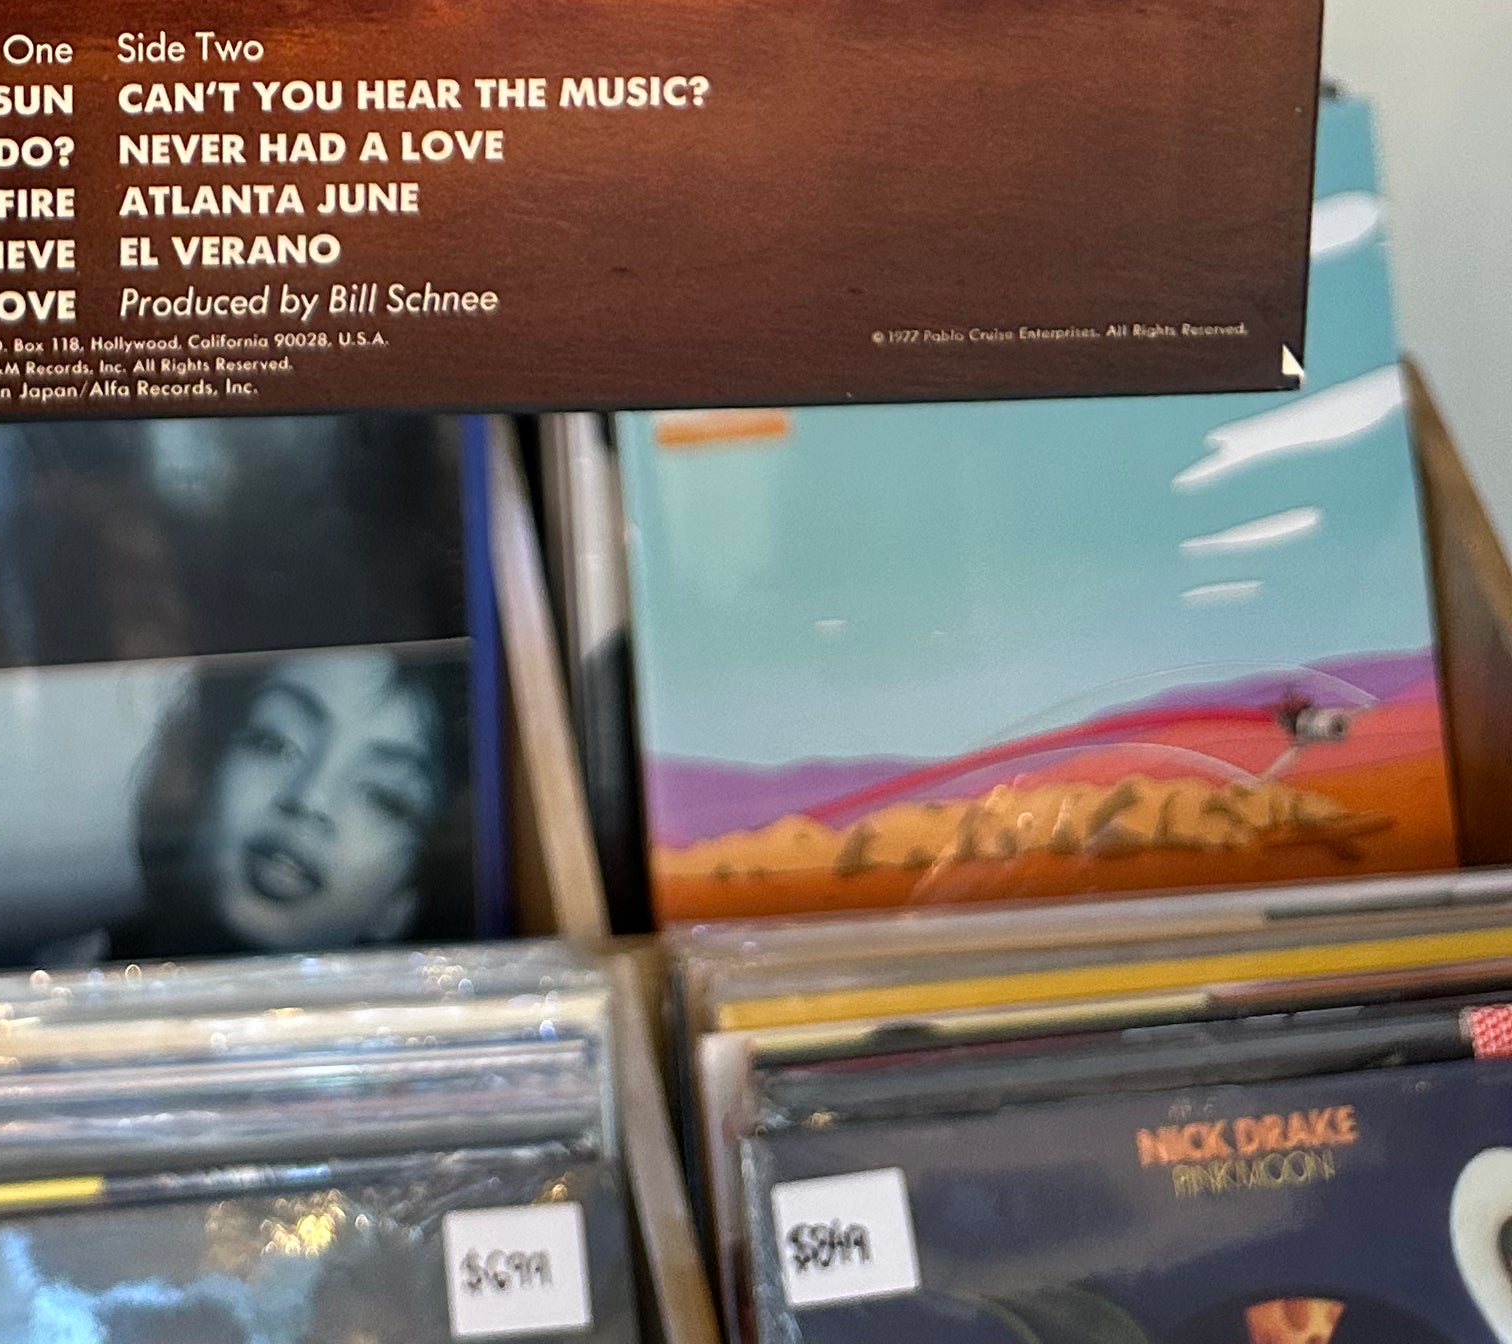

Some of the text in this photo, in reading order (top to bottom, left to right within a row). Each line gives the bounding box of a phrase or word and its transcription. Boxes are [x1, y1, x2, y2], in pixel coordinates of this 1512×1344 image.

[2, 33, 74, 67] One
[117, 30, 265, 65] Side Two
[118, 75, 711, 115] CAN'T YOU HEAR THE MUSIC?
[119, 129, 505, 166] NEVER HAD A LOVE
[118, 182, 420, 217] ATLANTA JUNE
[119, 233, 342, 270] EL VERANO
[119, 281, 499, 324] Produced by Bill Schnee
[13, 337, 44, 353] Box
[52, 336, 85, 354] 118,
[90, 335, 183, 354] Hollywood,
[188, 333, 270, 350] California
[273, 332, 333, 349] 90028,
[338, 331, 390, 347] U.S.A.
[888, 329, 920, 343] 1977
[923, 328, 965, 343] Pablo
[968, 327, 1014, 342] Cruise
[1105, 323, 1128, 338] All
[1131, 322, 1177, 339] Rights
[1181, 321, 1249, 337] Reserved.
[25, 359, 94, 376] Records,
[99, 358, 127, 374] Inc.
[132, 357, 156, 373] All
[160, 356, 210, 375] Rights
[215, 355, 294, 373] Reserved.
[137, 377, 218, 397] Records,
[225, 376, 259, 395] Inc.
[1136, 1118, 1235, 1167] NICK
[1233, 1104, 1359, 1157] DRAKE
